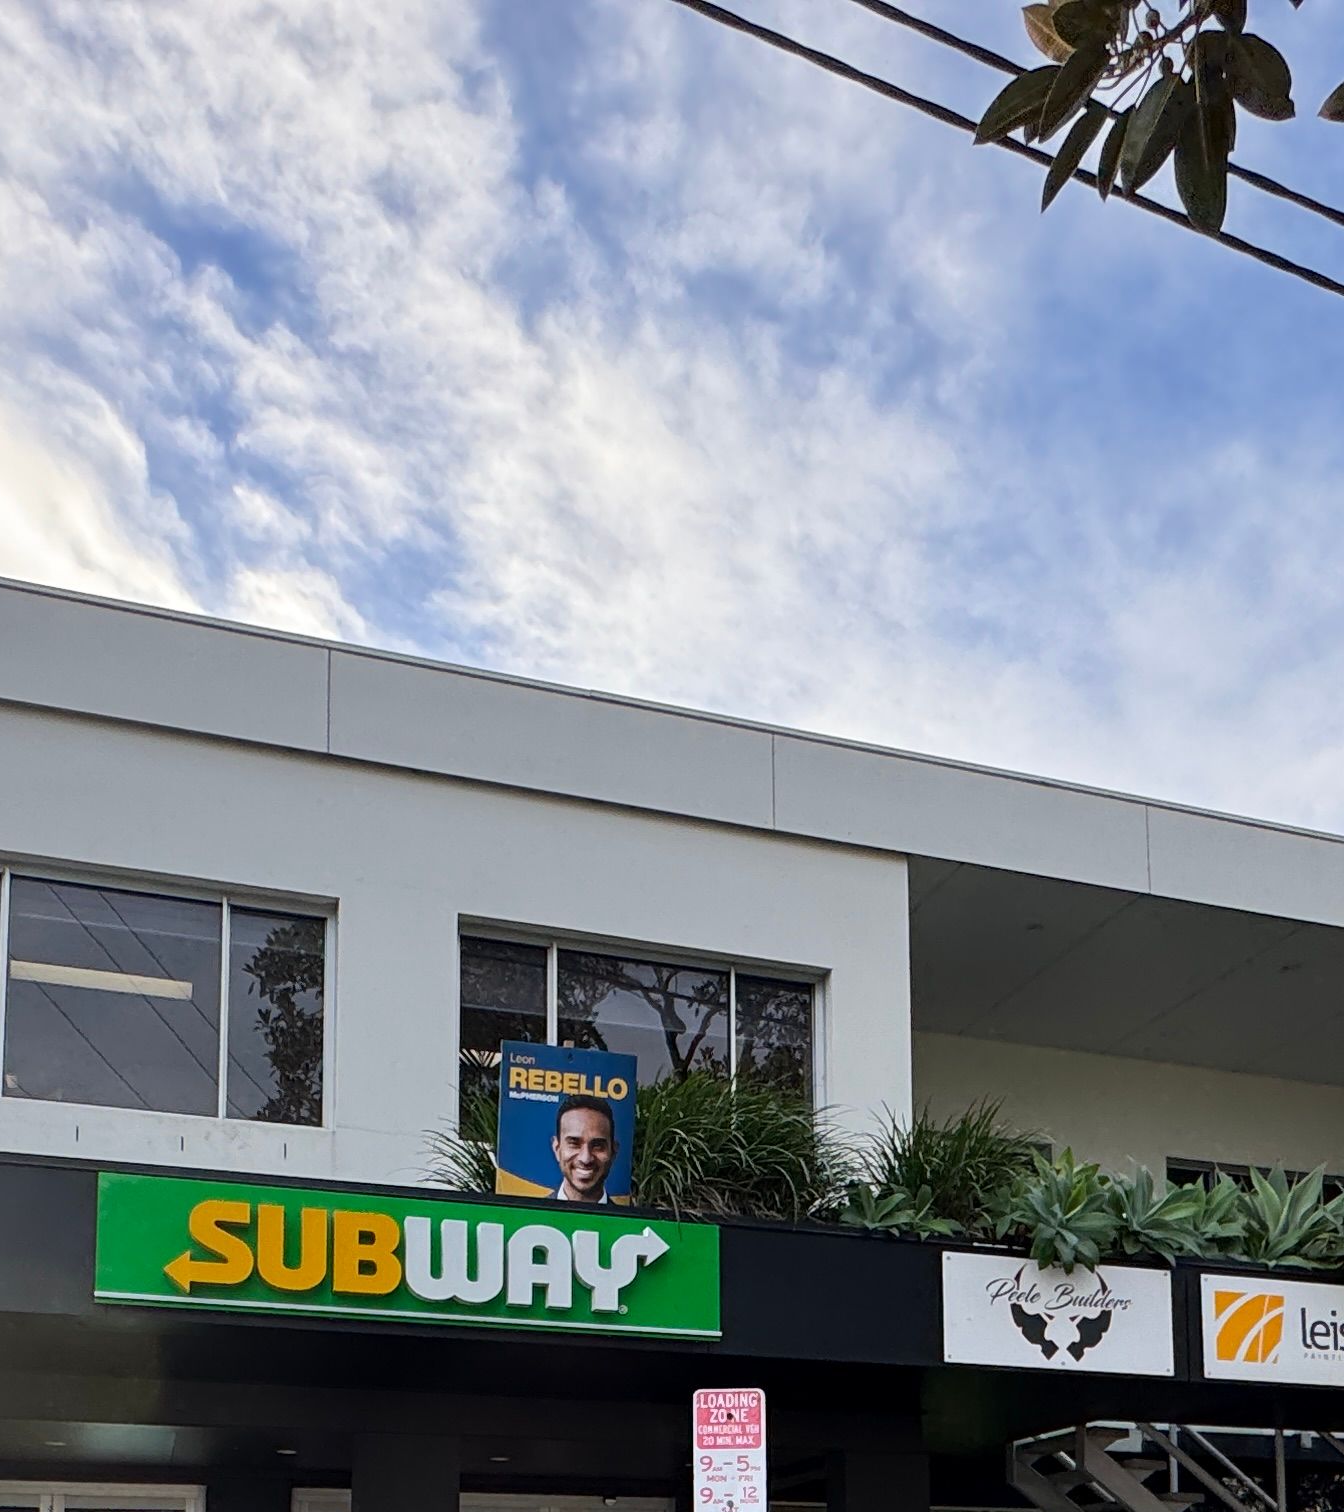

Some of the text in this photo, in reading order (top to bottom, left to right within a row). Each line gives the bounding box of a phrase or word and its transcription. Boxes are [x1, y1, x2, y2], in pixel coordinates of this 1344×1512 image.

[510, 1053, 535, 1065] Leon
[509, 1067, 628, 1100] REBELLO
[163, 1199, 670, 1312] SUBWAY
[1044, 1283, 1133, 1311] Builders
[700, 1393, 757, 1408] LOADING
[709, 1408, 749, 1423] ZONE
[702, 1435, 714, 1446] 20
